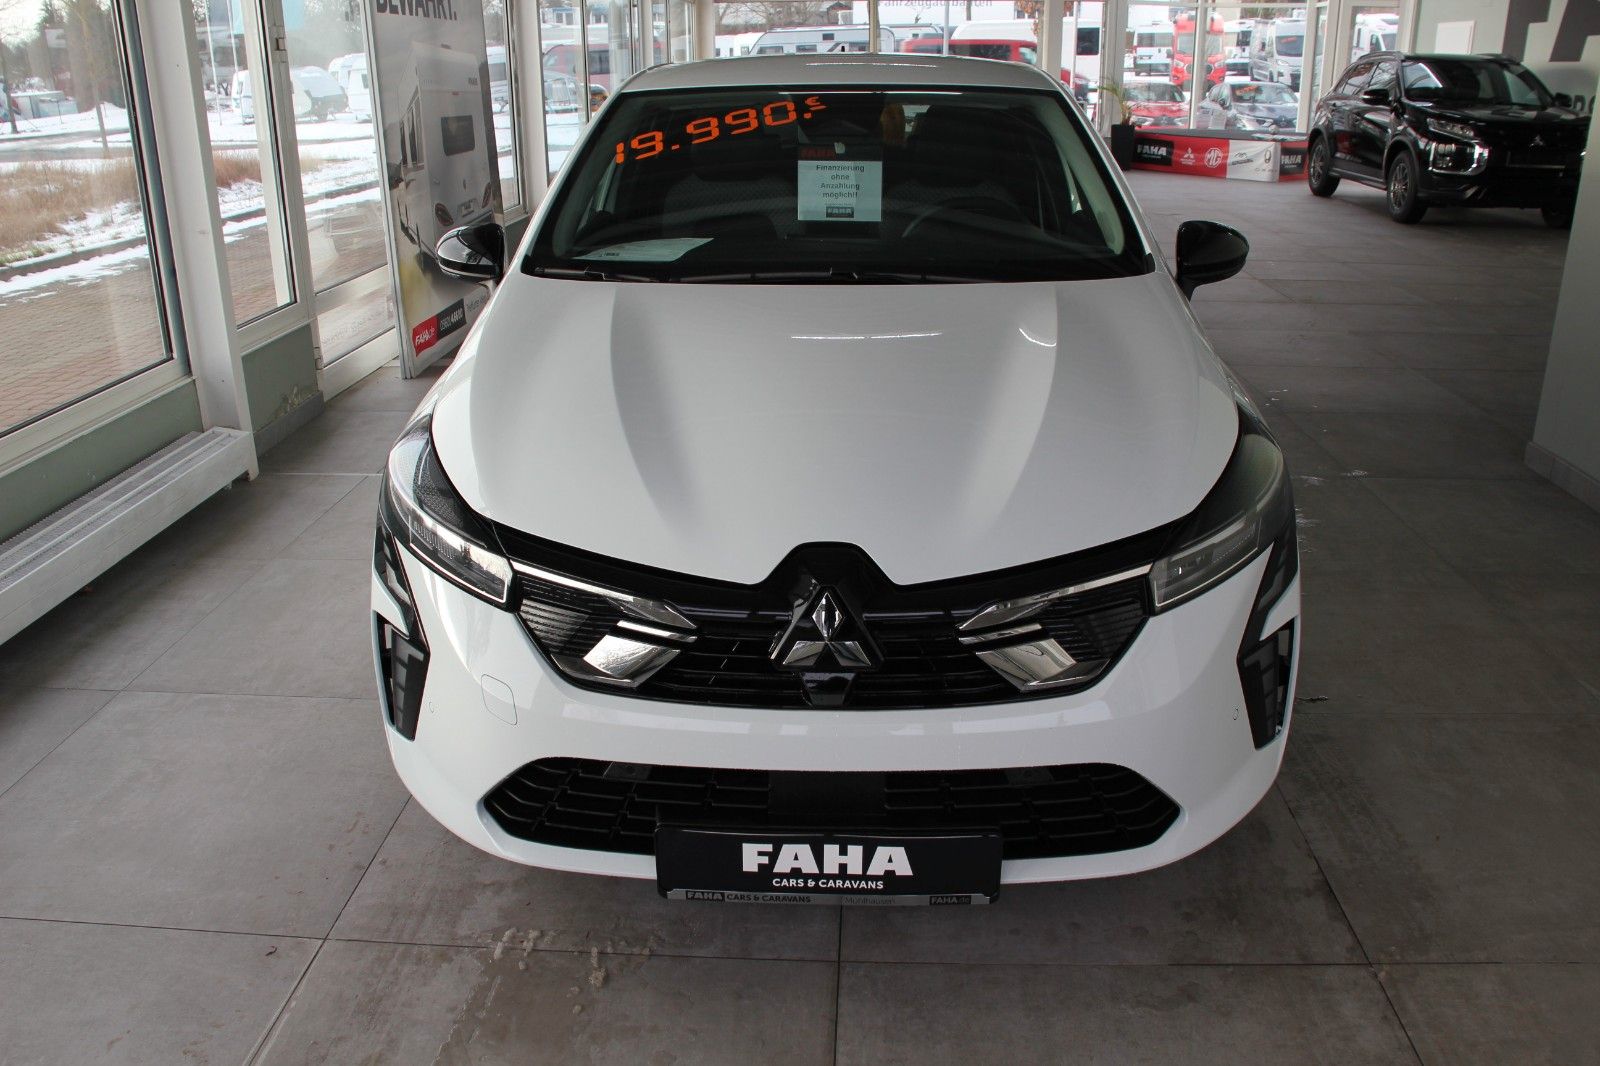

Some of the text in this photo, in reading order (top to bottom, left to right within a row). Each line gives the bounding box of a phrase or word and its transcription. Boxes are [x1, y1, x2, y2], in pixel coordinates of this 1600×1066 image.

[1137, 145, 1167, 156] FAHA
[1205, 148, 1223, 166] MG
[820, 183, 860, 191] Anzahlung
[742, 843, 913, 876] FAHA
[772, 878, 884, 889] CARS & CARAVANS
[686, 892, 723, 901] FAHA
[726, 894, 752, 902] CARS
[762, 895, 811, 903] CARAVANS
[931, 896, 970, 904] FAHA.de
